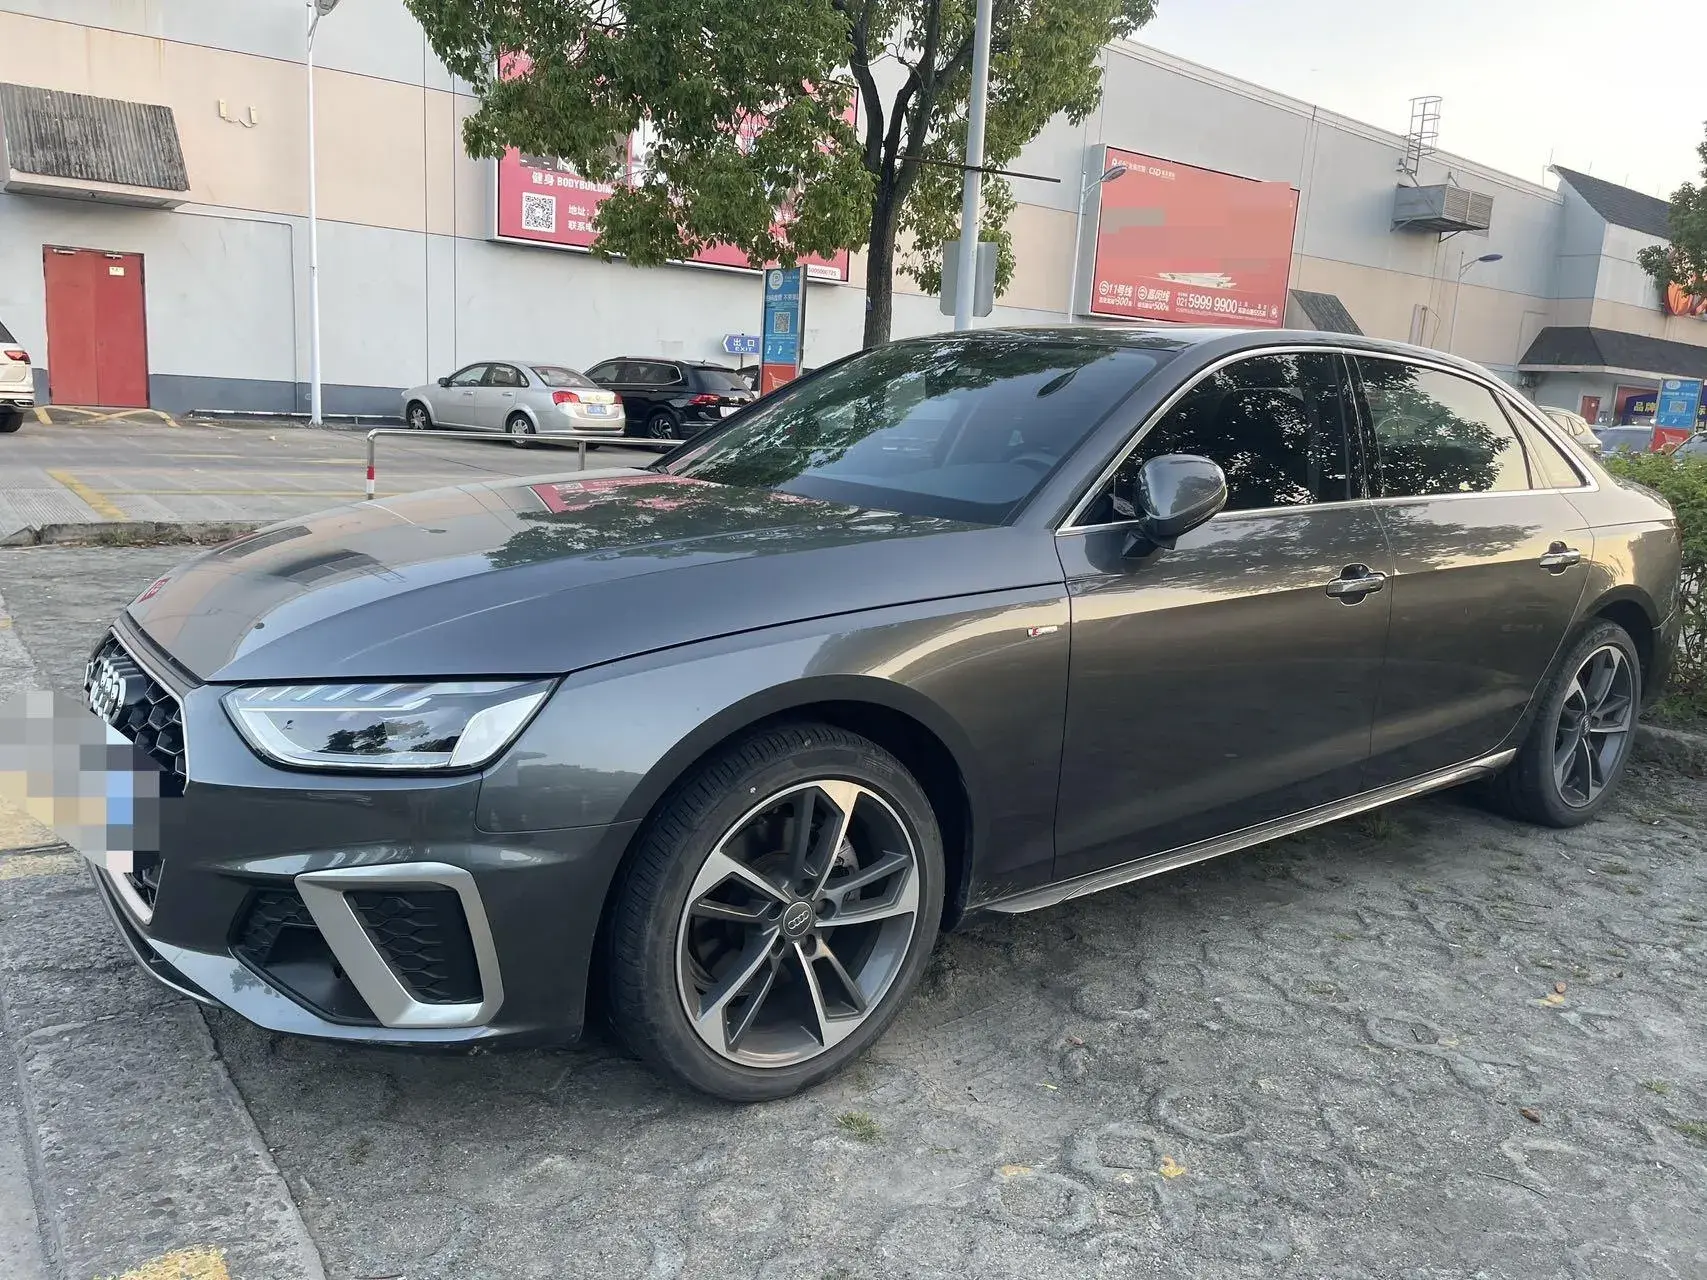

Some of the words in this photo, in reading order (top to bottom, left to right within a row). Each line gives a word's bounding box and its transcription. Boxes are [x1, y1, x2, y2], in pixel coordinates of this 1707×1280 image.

[532, 171, 554, 186] 健身
[557, 177, 616, 194] BODYBUILDIN
[1176, 297, 1187, 307] 021
[1188, 294, 1212, 310] 5999
[1214, 297, 1237, 313] 9900
